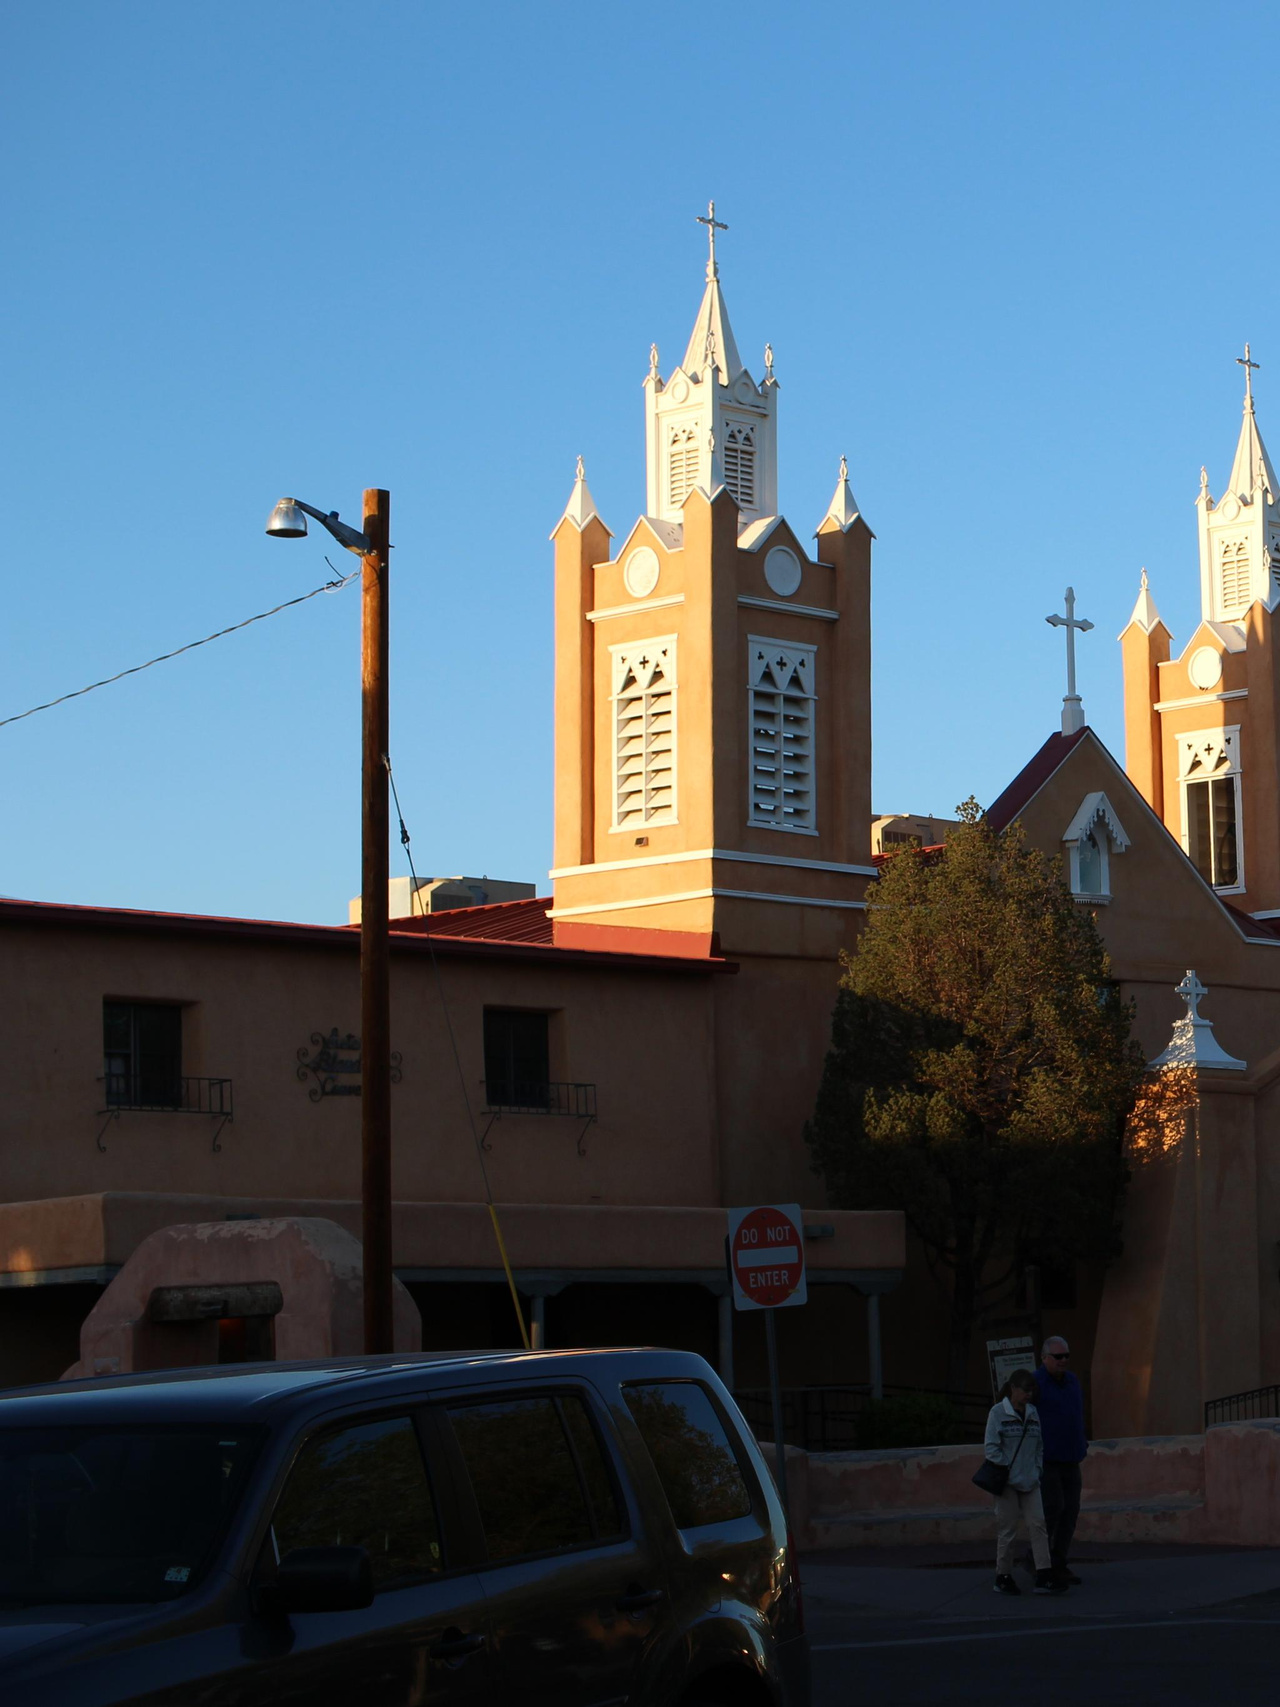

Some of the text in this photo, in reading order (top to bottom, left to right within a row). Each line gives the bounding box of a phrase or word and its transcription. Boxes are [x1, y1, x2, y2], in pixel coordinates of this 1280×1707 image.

[741, 1225, 790, 1244] DO NOT
[749, 1270, 789, 1288] ENTER
